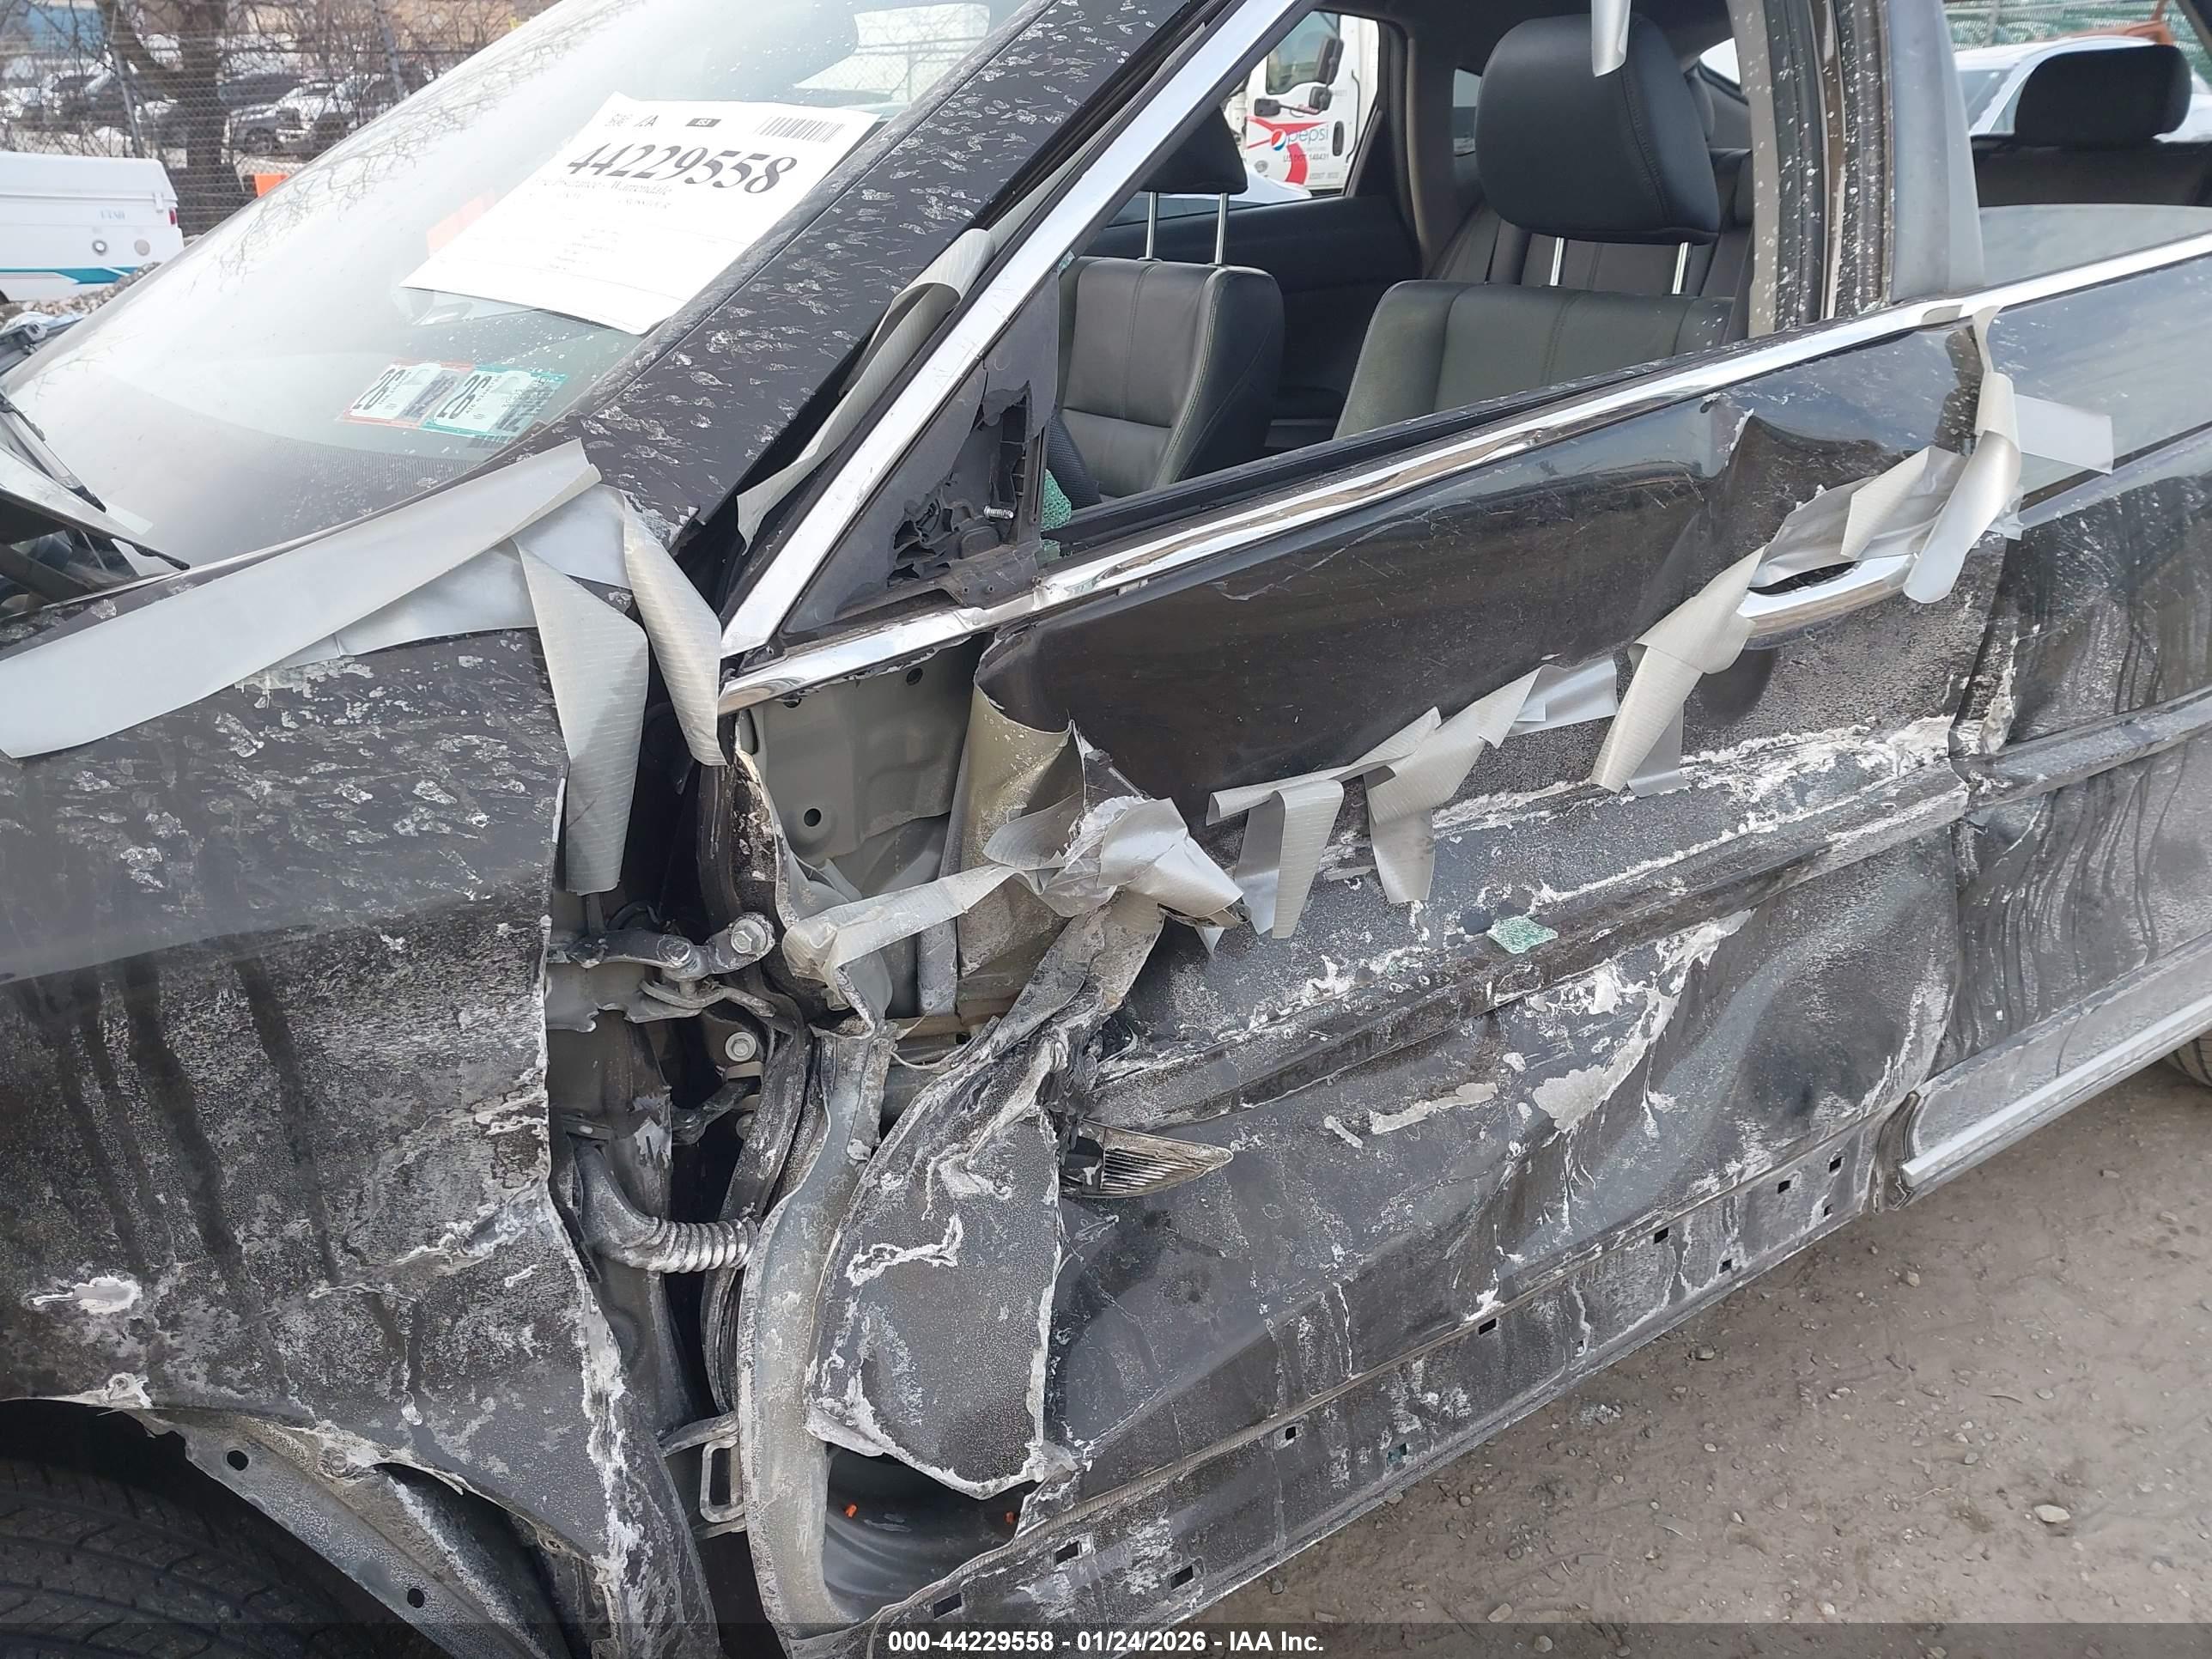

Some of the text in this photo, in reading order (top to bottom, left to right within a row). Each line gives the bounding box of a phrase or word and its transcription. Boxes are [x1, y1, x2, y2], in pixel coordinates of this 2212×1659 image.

[1288, 125, 1329, 144] pepsi
[567, 142, 798, 194] 44229558
[351, 368, 406, 410] 26
[435, 374, 493, 420] 26
